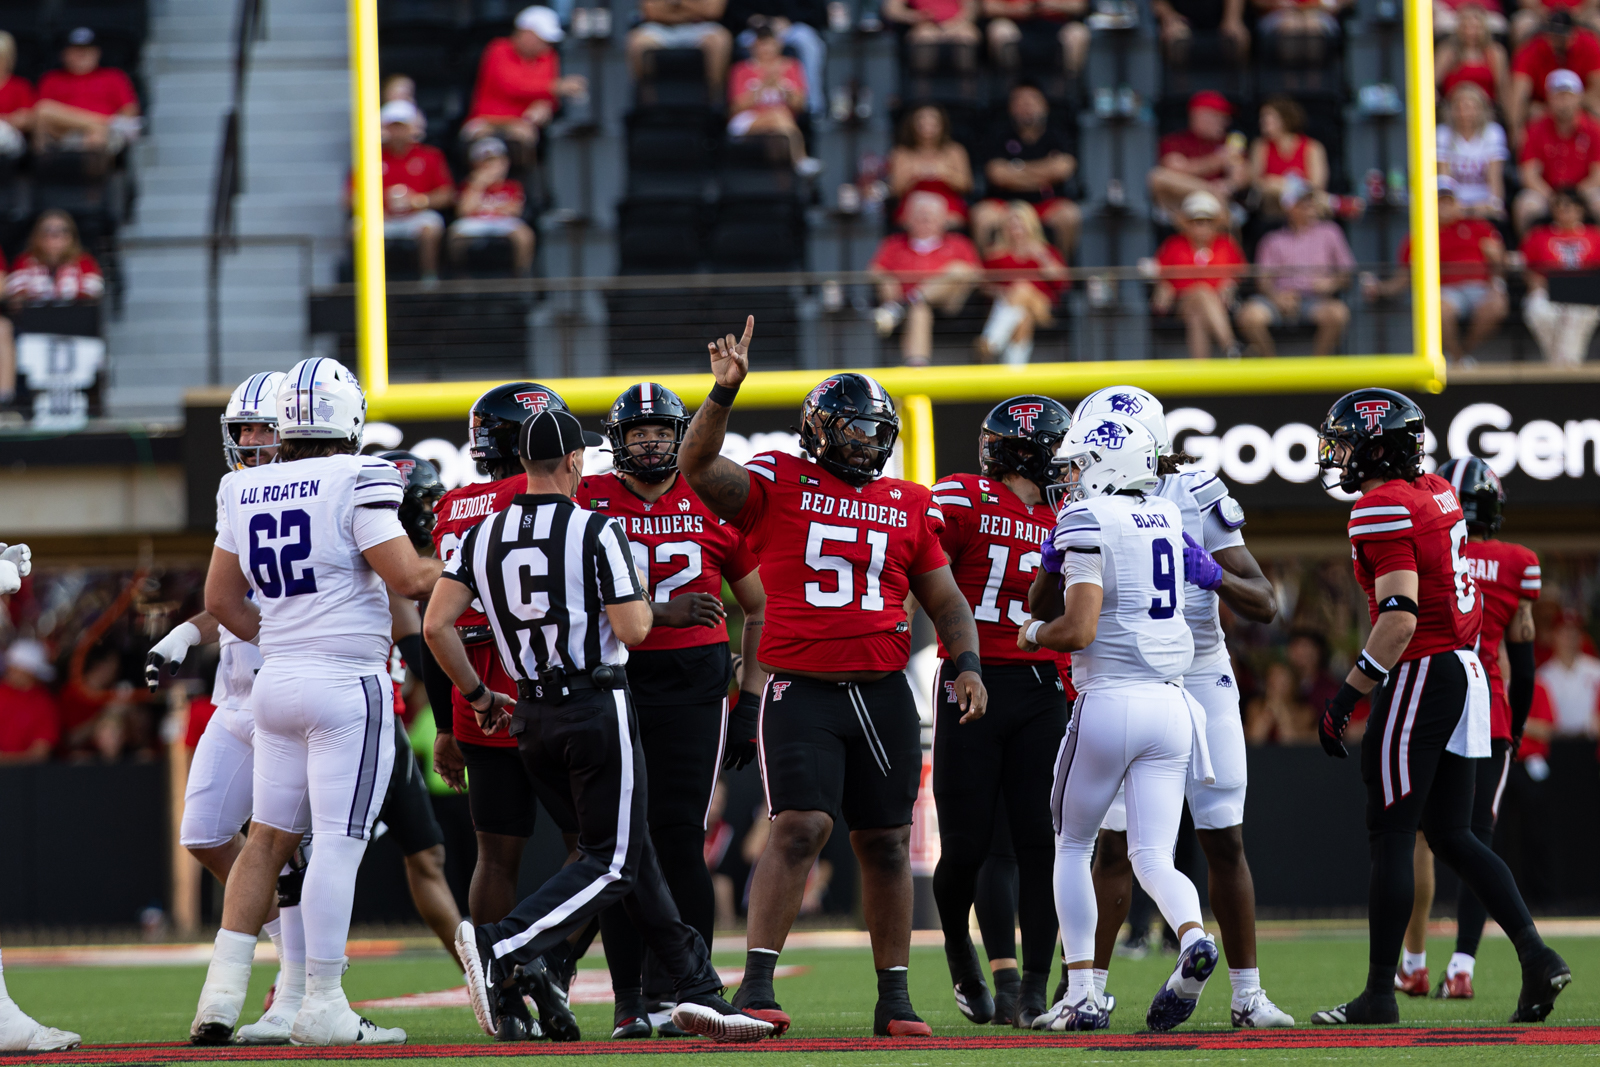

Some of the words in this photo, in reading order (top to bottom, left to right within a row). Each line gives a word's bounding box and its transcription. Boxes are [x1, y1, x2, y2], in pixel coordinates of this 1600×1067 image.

[262, 479, 321, 503] ROATEN
[978, 479, 990, 492] C
[448, 493, 496, 521] NEDORE
[800, 491, 836, 515] RED
[838, 498, 908, 528] RAIDERS
[1131, 513, 1170, 528] BLACK
[631, 515, 704, 534] RAIDERS
[979, 514, 1011, 537] RED
[1014, 520, 1052, 545] RAID
[249, 508, 318, 598] 62
[804, 521, 889, 611] 51
[501, 546, 550, 621] C
[1147, 537, 1177, 620] 9
